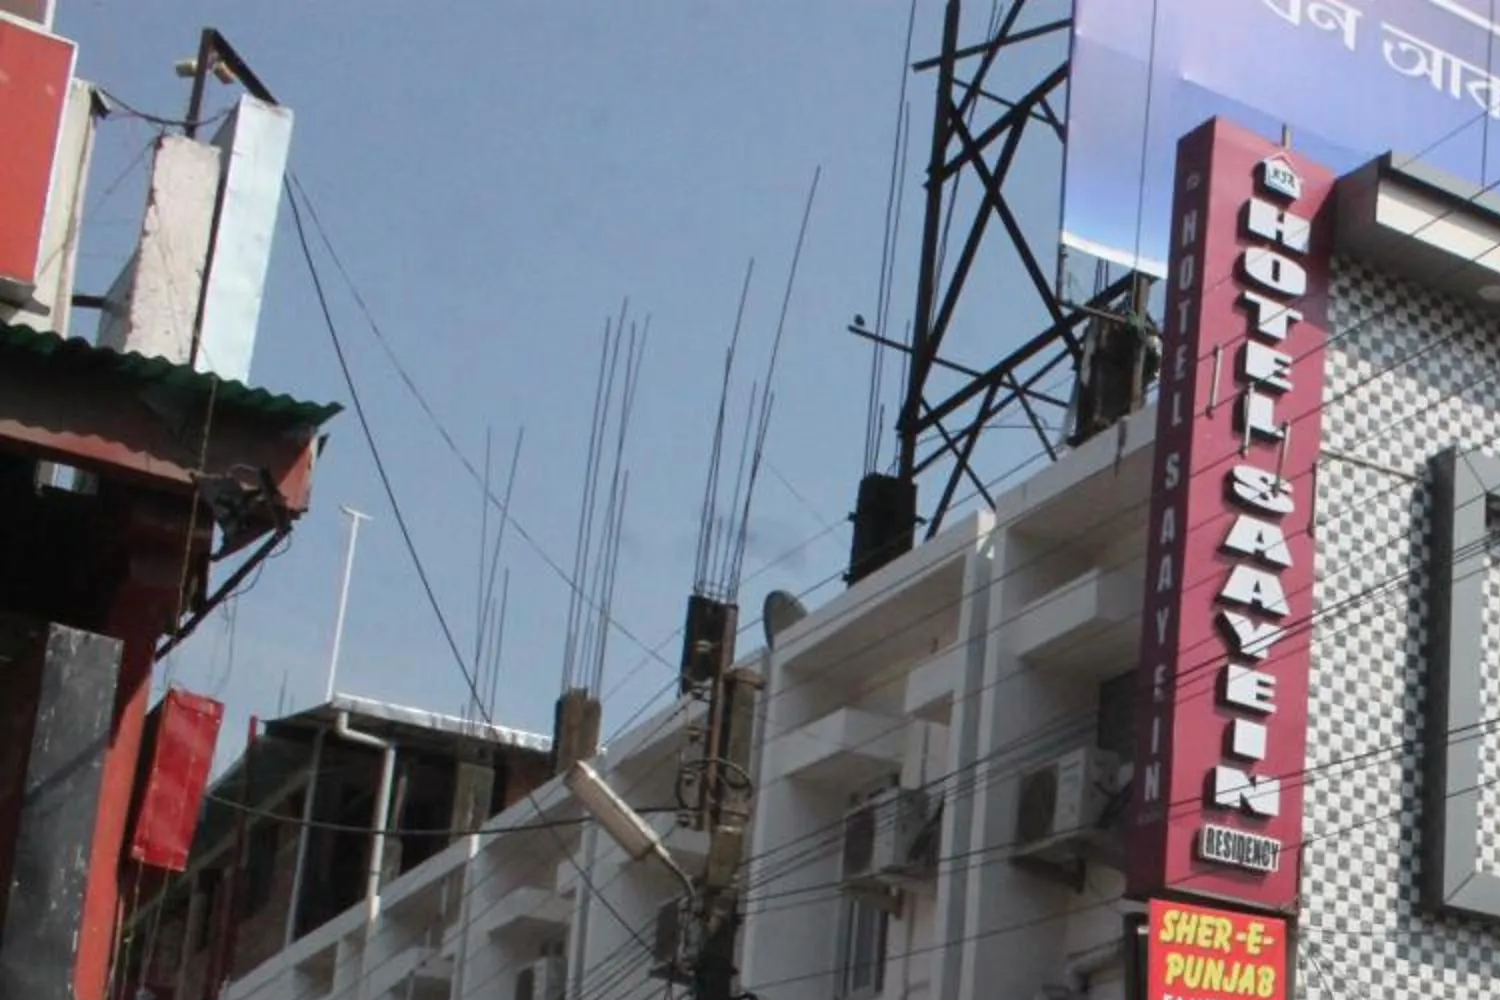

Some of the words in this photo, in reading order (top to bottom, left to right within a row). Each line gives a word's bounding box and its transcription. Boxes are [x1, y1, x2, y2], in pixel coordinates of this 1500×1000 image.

[1169, 212, 1197, 427] HOTEL
[1244, 197, 1310, 438] HOTEL
[1214, 465, 1294, 817] SAAYEIN
[1205, 826, 1280, 870] RESIDENCY
[1159, 909, 1231, 950] SHER
[1165, 952, 1275, 998] PUNJAB
